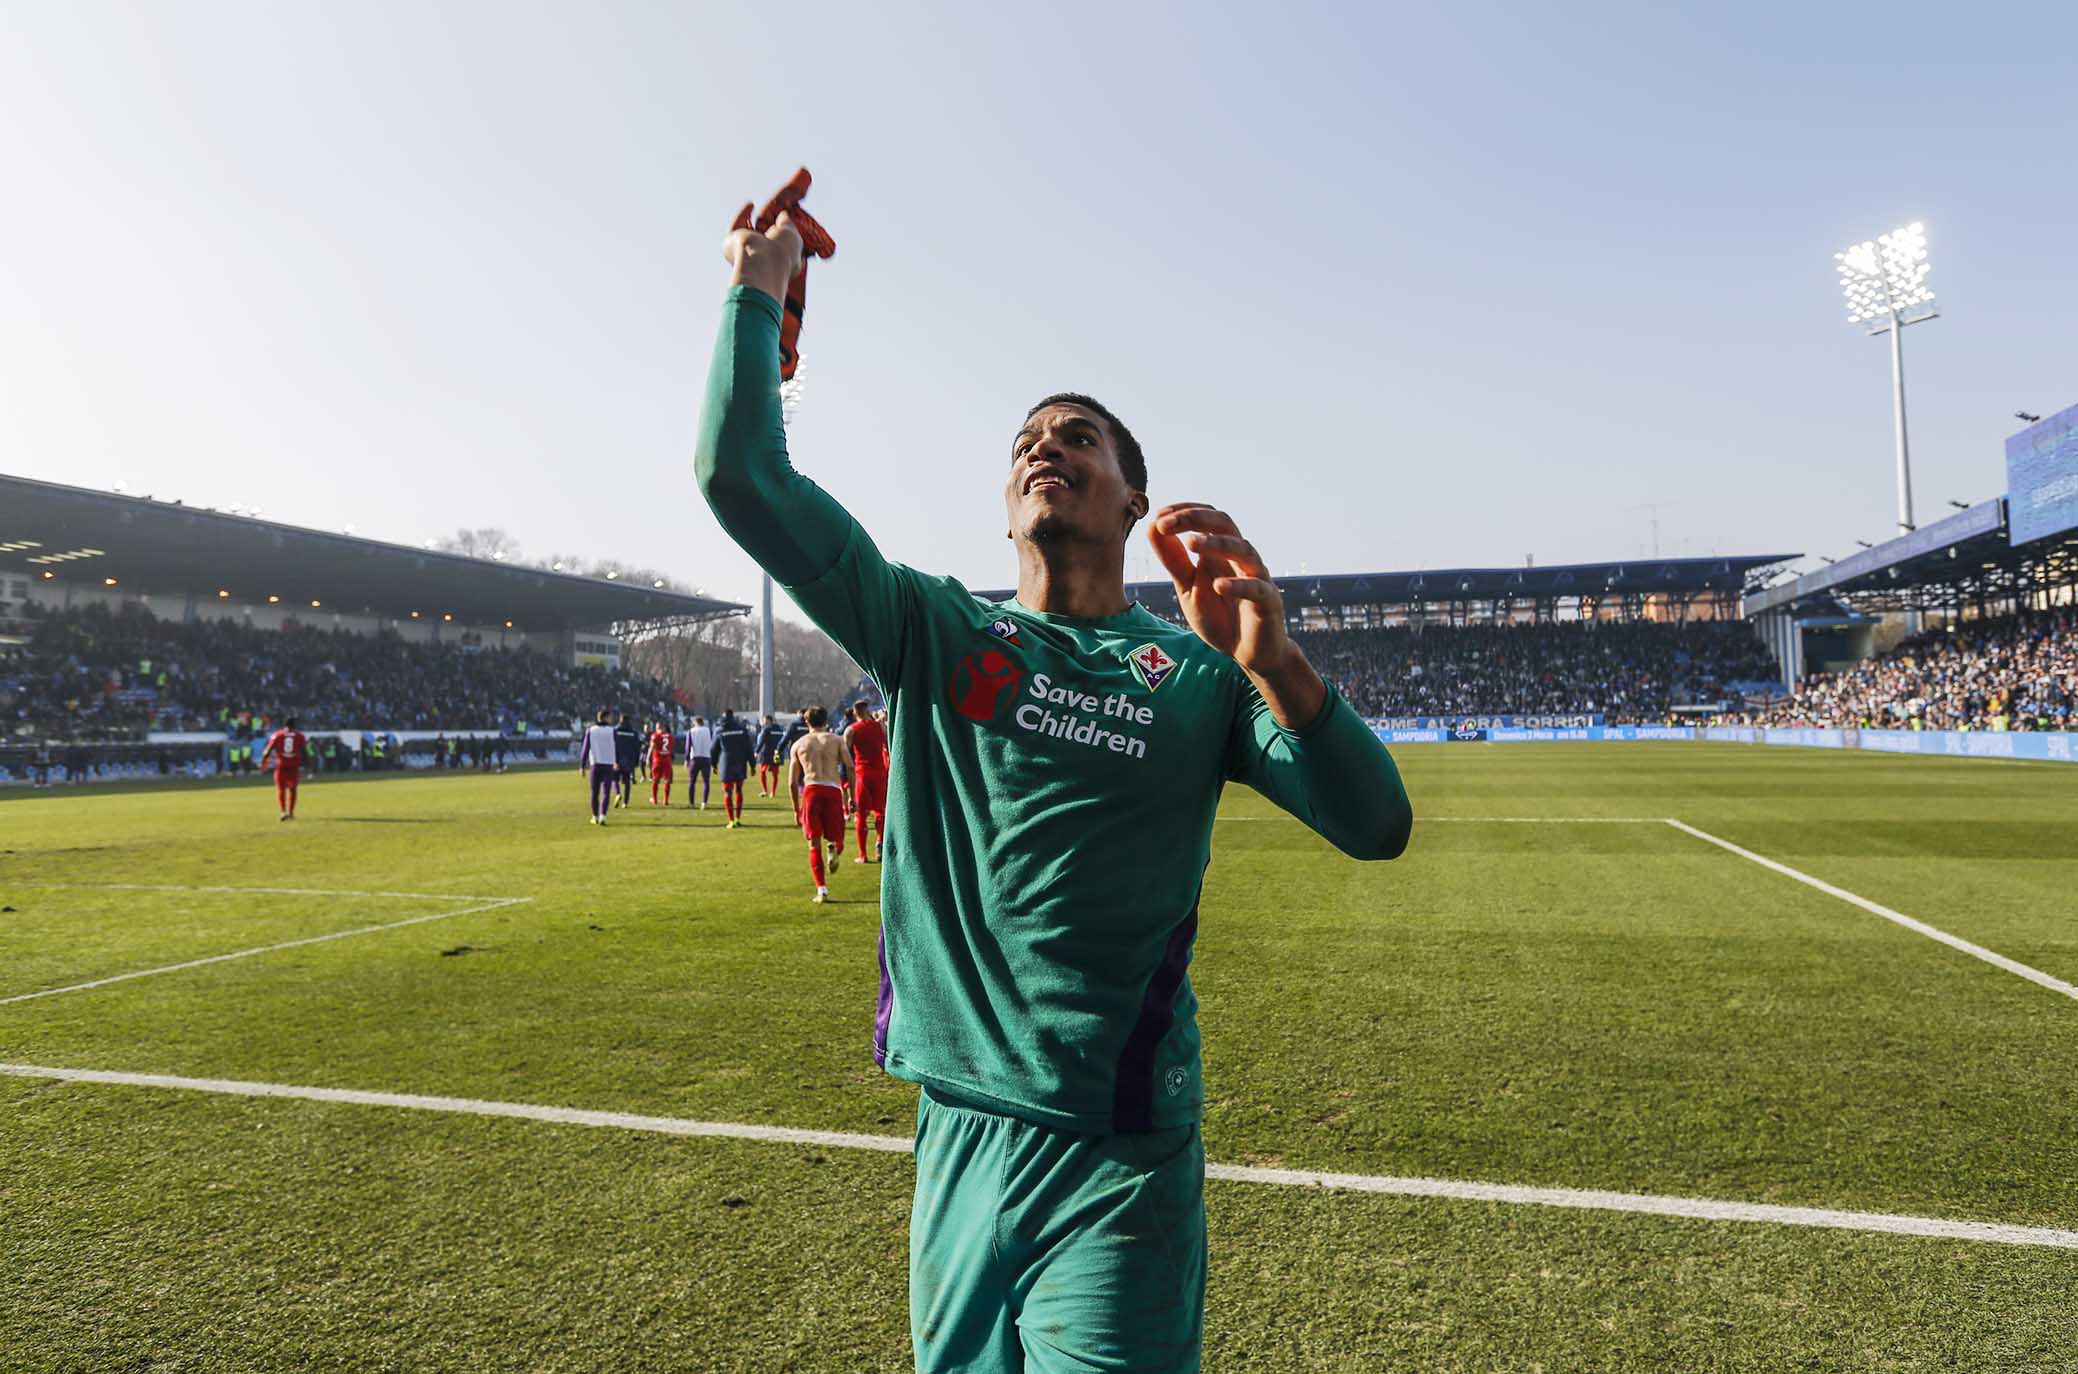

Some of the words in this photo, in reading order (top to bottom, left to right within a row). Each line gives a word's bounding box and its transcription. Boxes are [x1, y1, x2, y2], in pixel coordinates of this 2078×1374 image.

[1029, 673, 1098, 713] Save
[1103, 694, 1154, 725] the
[662, 738, 669, 752] 2
[1015, 704, 1147, 758] Children
